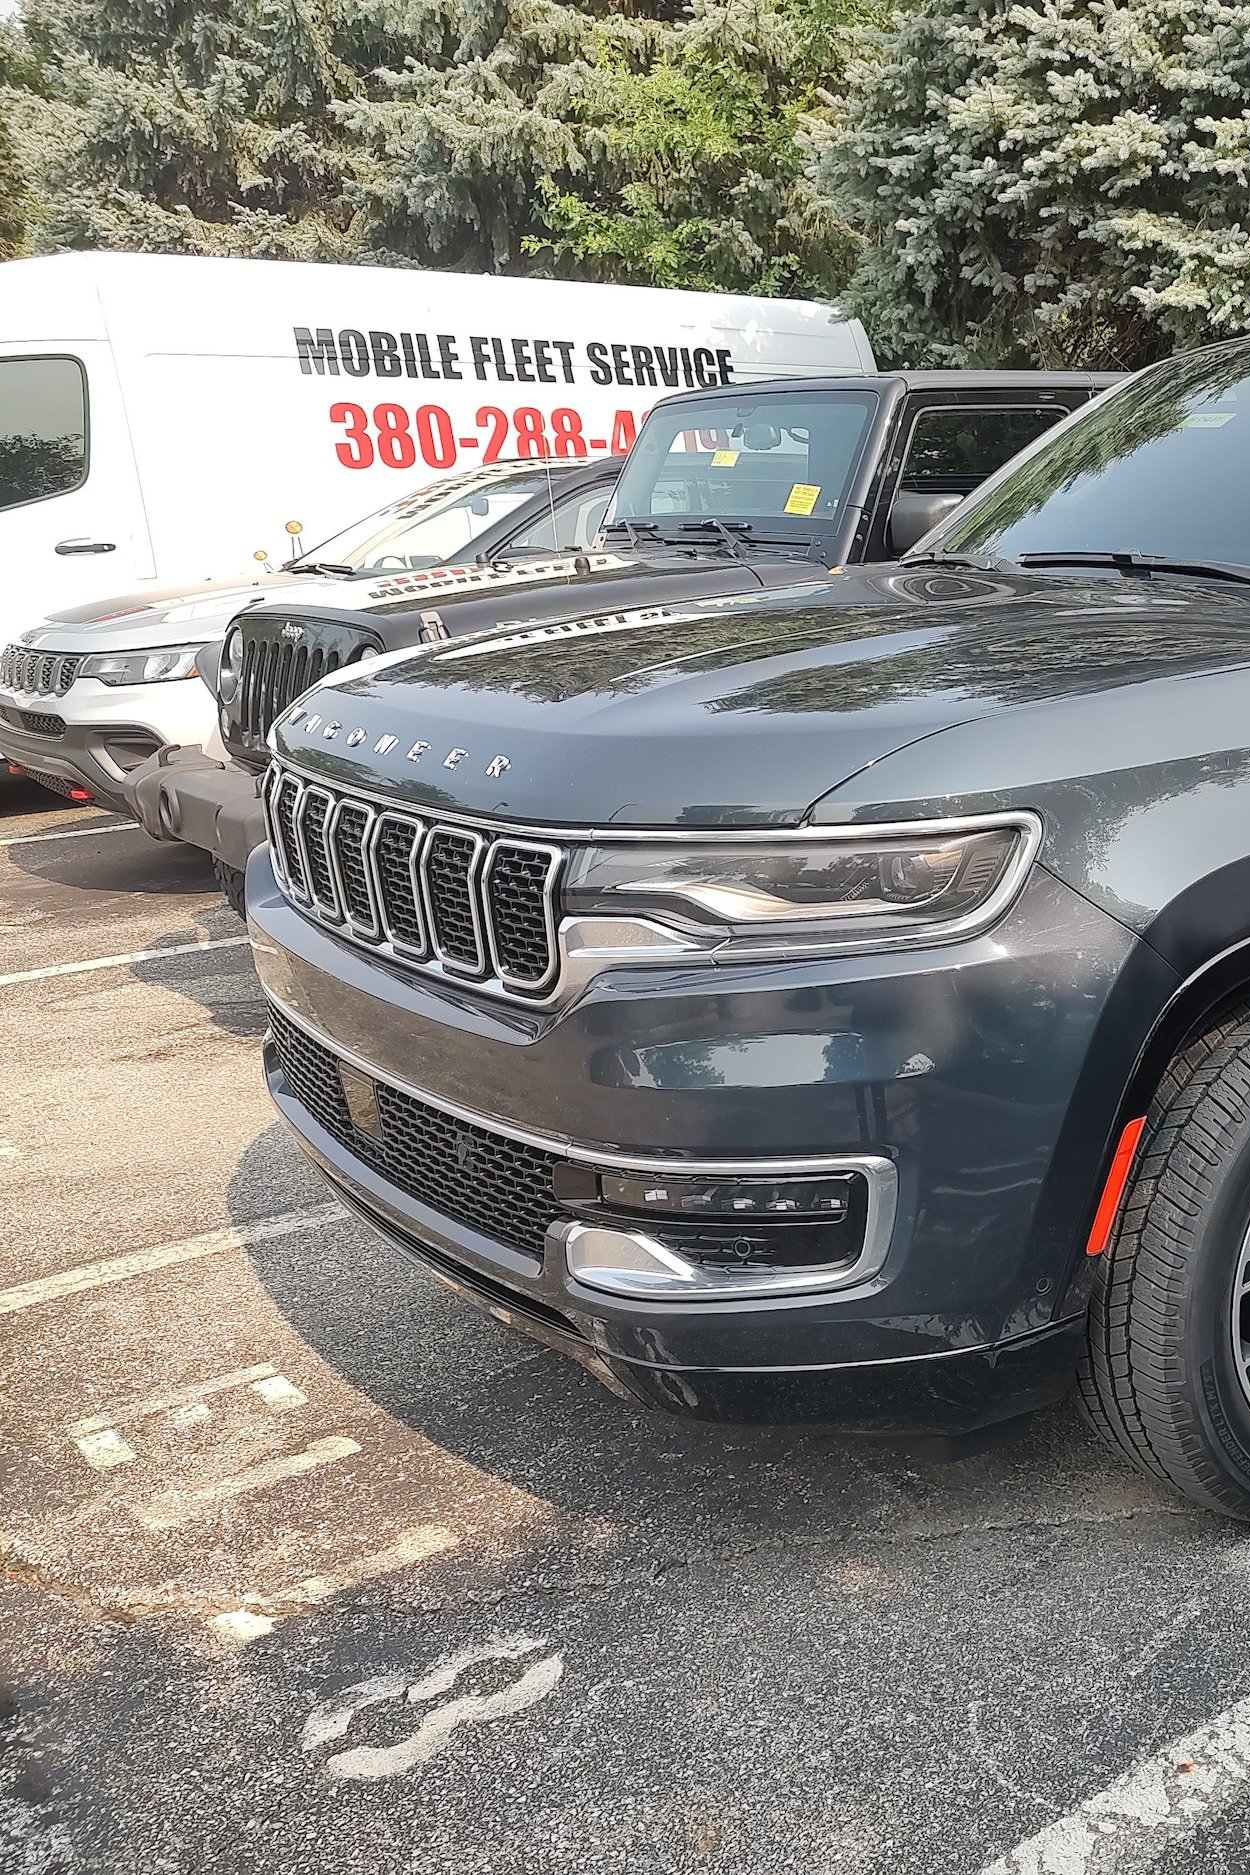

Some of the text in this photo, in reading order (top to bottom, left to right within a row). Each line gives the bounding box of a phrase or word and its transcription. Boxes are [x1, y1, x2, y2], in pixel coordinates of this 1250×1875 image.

[293, 326, 737, 388] MOBILE FLEET SERVICE
[281, 621, 305, 642] Jeep
